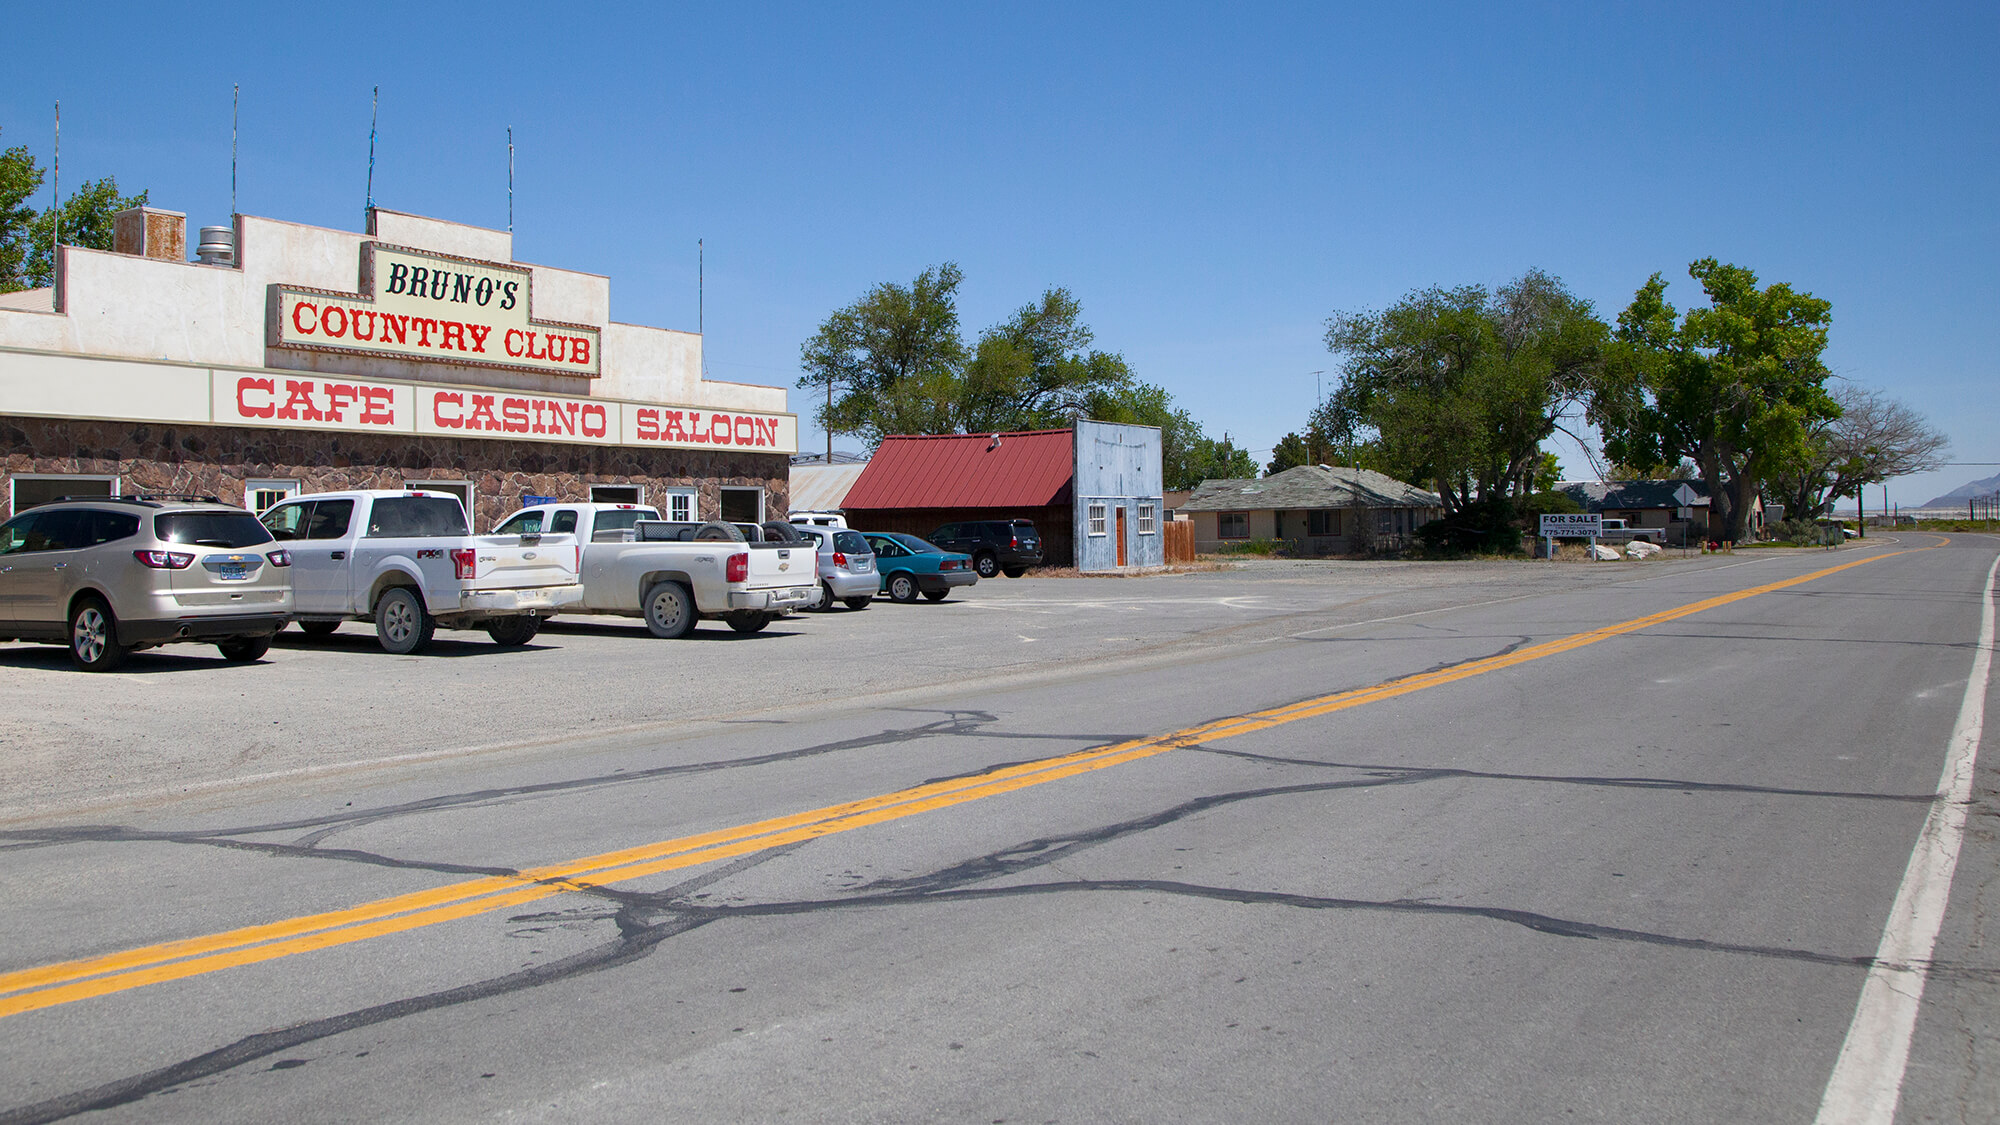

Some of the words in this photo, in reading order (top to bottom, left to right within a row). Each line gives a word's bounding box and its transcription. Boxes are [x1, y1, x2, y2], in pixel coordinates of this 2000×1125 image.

[386, 263, 519, 310] BRUNO'S
[292, 301, 492, 354] COUNTRY
[503, 328, 591, 365] CLUB
[236, 377, 394, 425] CAFE
[433, 391, 607, 438] CASINO
[637, 408, 779, 447] SALOON
[1543, 515, 1566, 523] FOR
[1568, 515, 1598, 523] SALE
